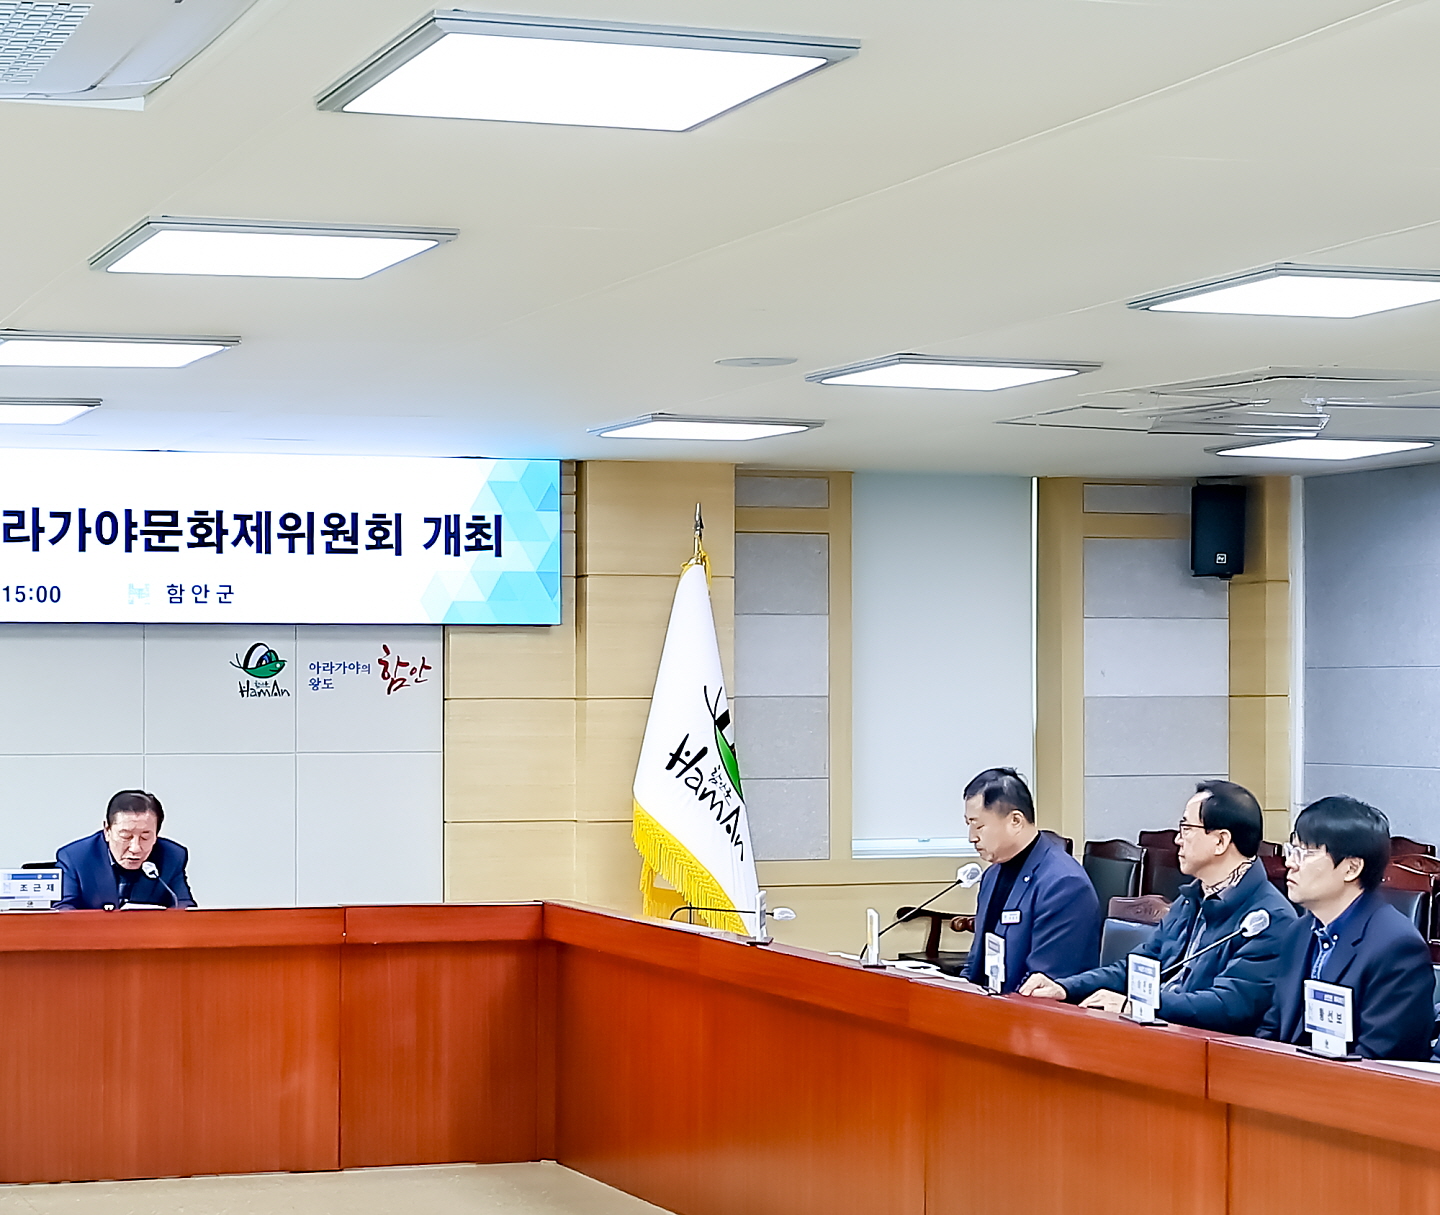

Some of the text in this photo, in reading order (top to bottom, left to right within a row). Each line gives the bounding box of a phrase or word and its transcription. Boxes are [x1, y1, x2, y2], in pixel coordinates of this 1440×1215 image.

[422, 512, 504, 558] 개최
[1, 584, 62, 603] 15:00
[309, 661, 371, 675] 아라가야의
[377, 644, 433, 695] 함안
[308, 677, 335, 691] 왕도
